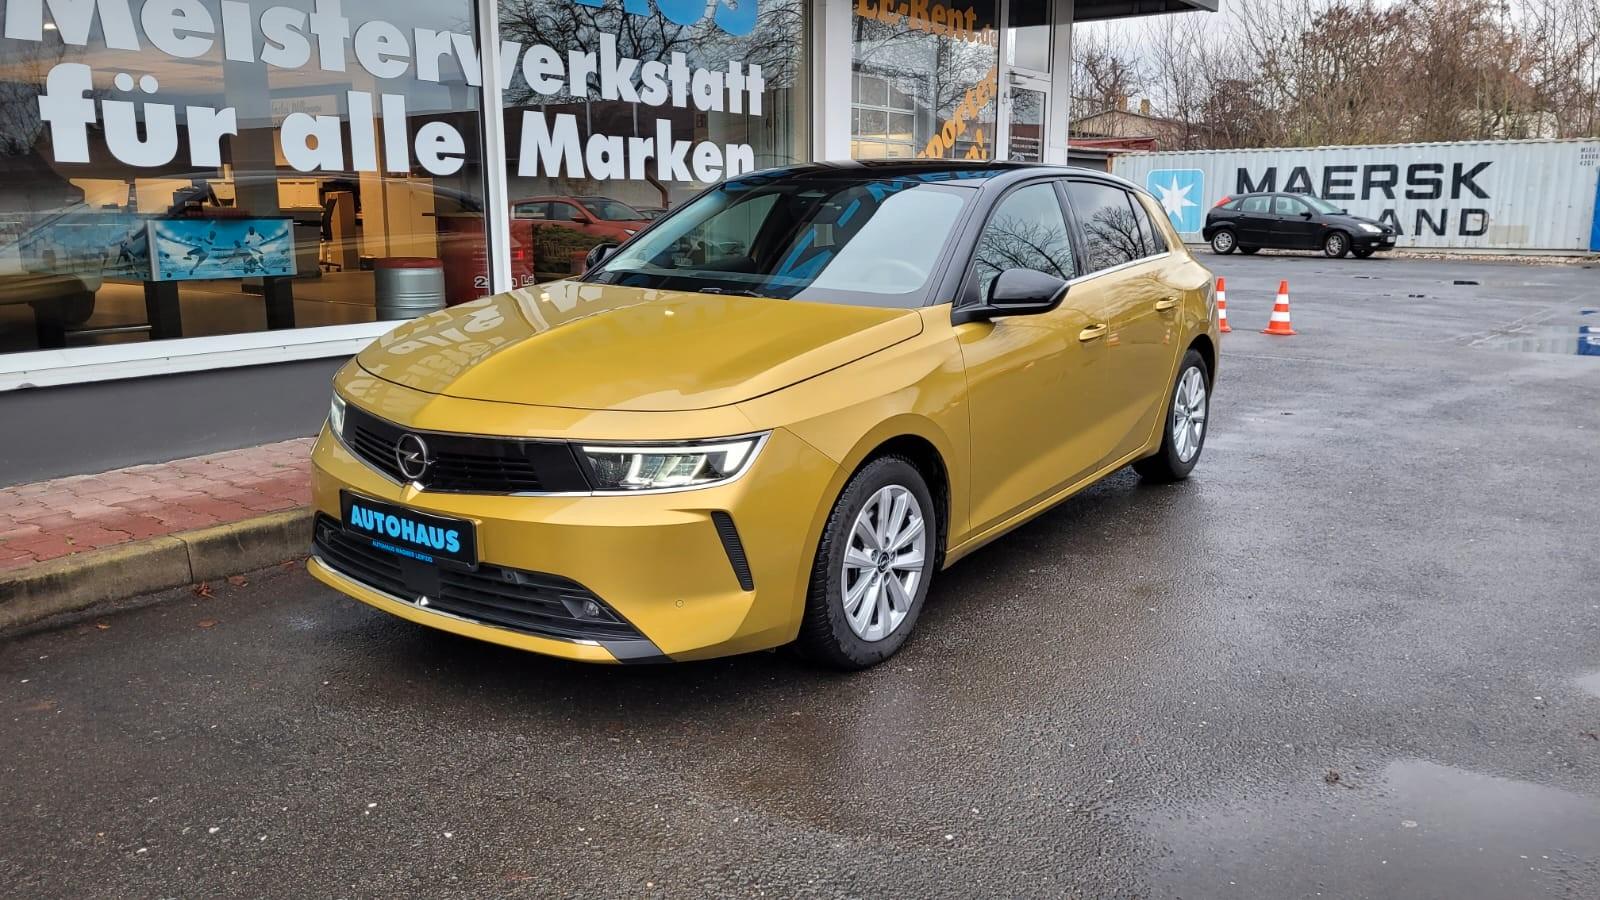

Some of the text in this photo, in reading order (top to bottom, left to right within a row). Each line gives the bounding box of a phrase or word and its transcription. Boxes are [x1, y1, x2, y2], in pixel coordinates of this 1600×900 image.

[38, 63, 755, 184] für alle Marken
[1236, 161, 1494, 201] MAERSK
[351, 504, 461, 553] AUTOHAUS
